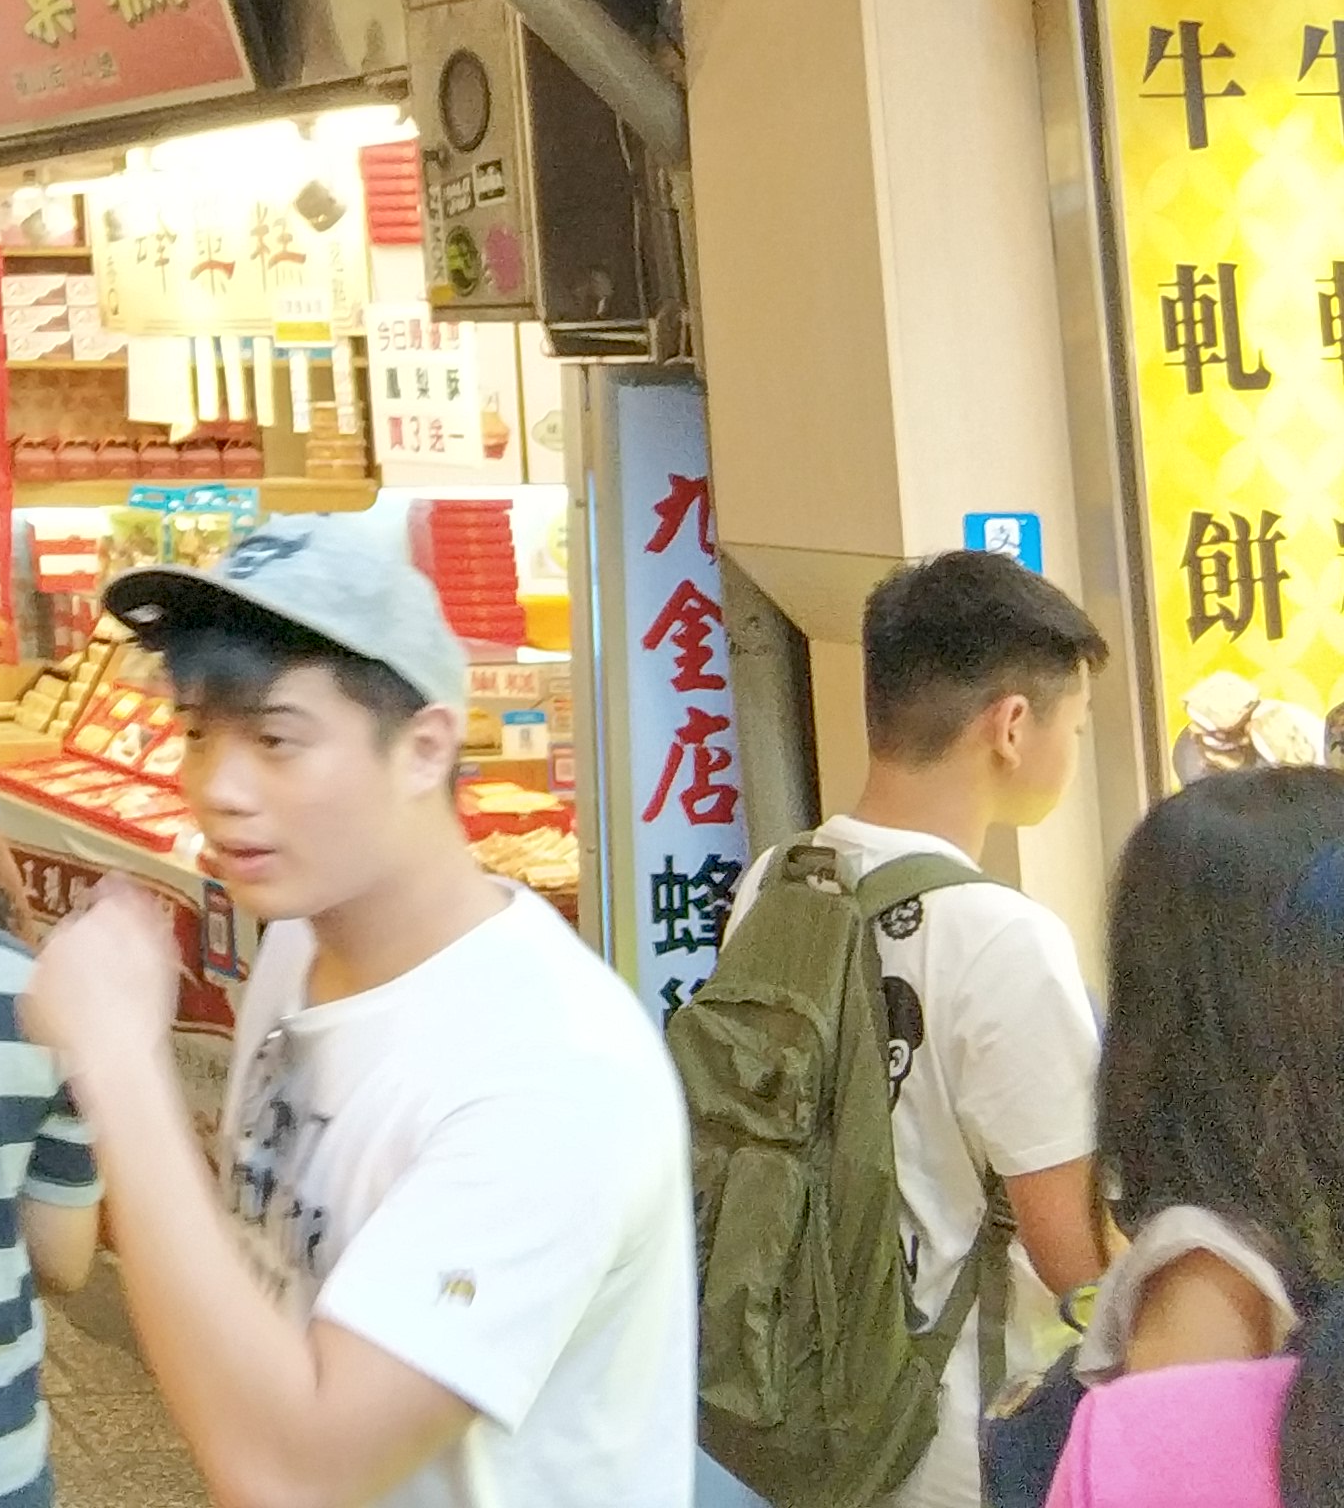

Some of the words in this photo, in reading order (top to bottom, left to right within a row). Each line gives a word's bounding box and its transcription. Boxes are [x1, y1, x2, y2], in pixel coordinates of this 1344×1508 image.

[1138, 19, 1290, 645] 牛軋餅
[642, 473, 740, 827] 九金店
